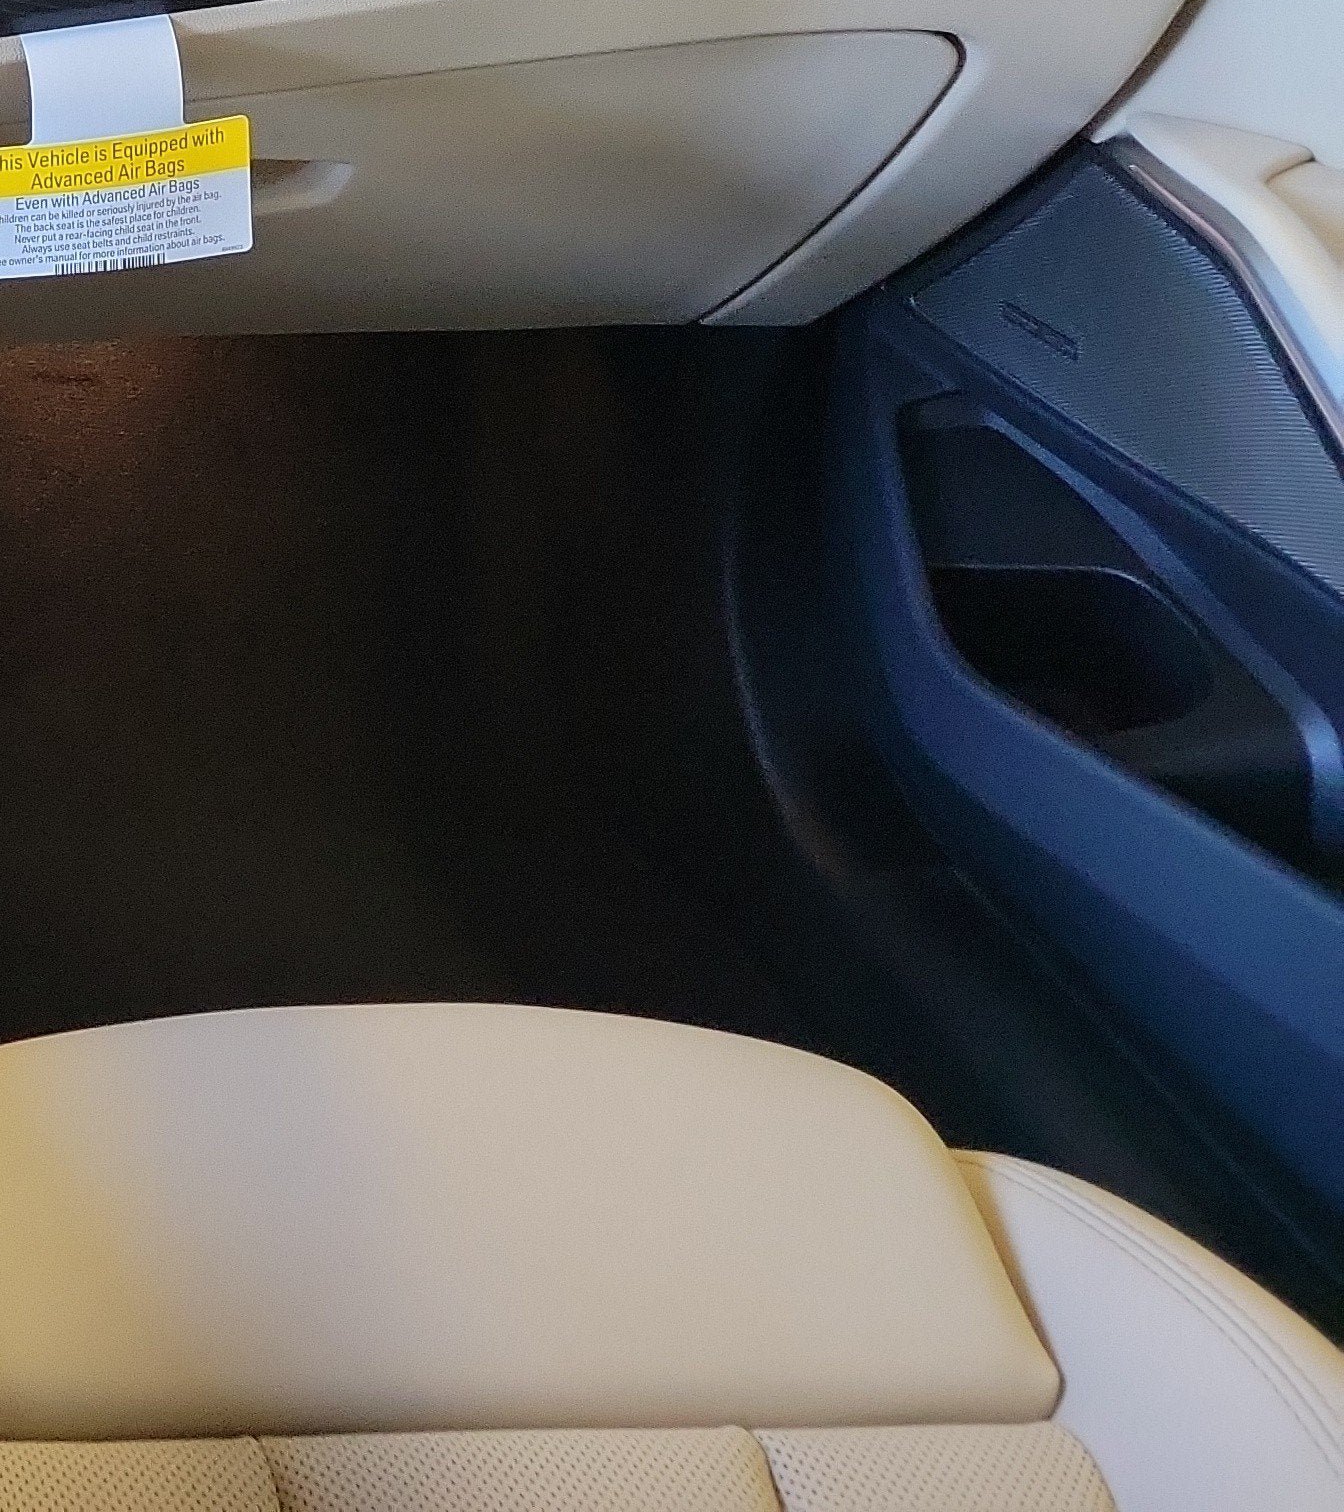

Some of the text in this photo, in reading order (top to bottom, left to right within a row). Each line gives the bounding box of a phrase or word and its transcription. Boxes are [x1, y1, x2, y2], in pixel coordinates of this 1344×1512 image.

[27, 147, 90, 169] Vehicle
[94, 144, 108, 163] is
[112, 131, 188, 161] Equipped
[192, 126, 225, 148] with
[31, 158, 185, 190] Advanced Air Bags
[15, 179, 200, 211] Even with Advanced Air Bags
[31, 212, 47, 221] can
[48, 209, 60, 220] be
[61, 206, 84, 219] killed
[86, 207, 96, 215] or
[97, 203, 136, 217] seriously
[136, 197, 165, 212] injured
[166, 195, 177, 208] by
[177, 192, 193, 202] the
[204, 189, 222, 201] bag.
[14, 231, 40, 244] Never
[41, 230, 58, 244] put
[65, 225, 113, 240] rear-facing
[114, 221, 135, 235] child
[136, 218, 155, 231] seat
[155, 217, 164, 229] in
[165, 215, 180, 227] the
[180, 210, 202, 225] front.
[15, 202, 201, 234] The back seat is the safest place for children.
[8, 250, 43, 266] owner's
[44, 248, 78, 263] manual
[78, 244, 92, 258] for
[92, 246, 116, 258] more
[116, 239, 166, 257] information
[166, 239, 191, 251] about
[190, 236, 202, 247] air
[202, 232, 225, 245] bags.
[21, 226, 195, 255] Always use seat belts and child restraints.
